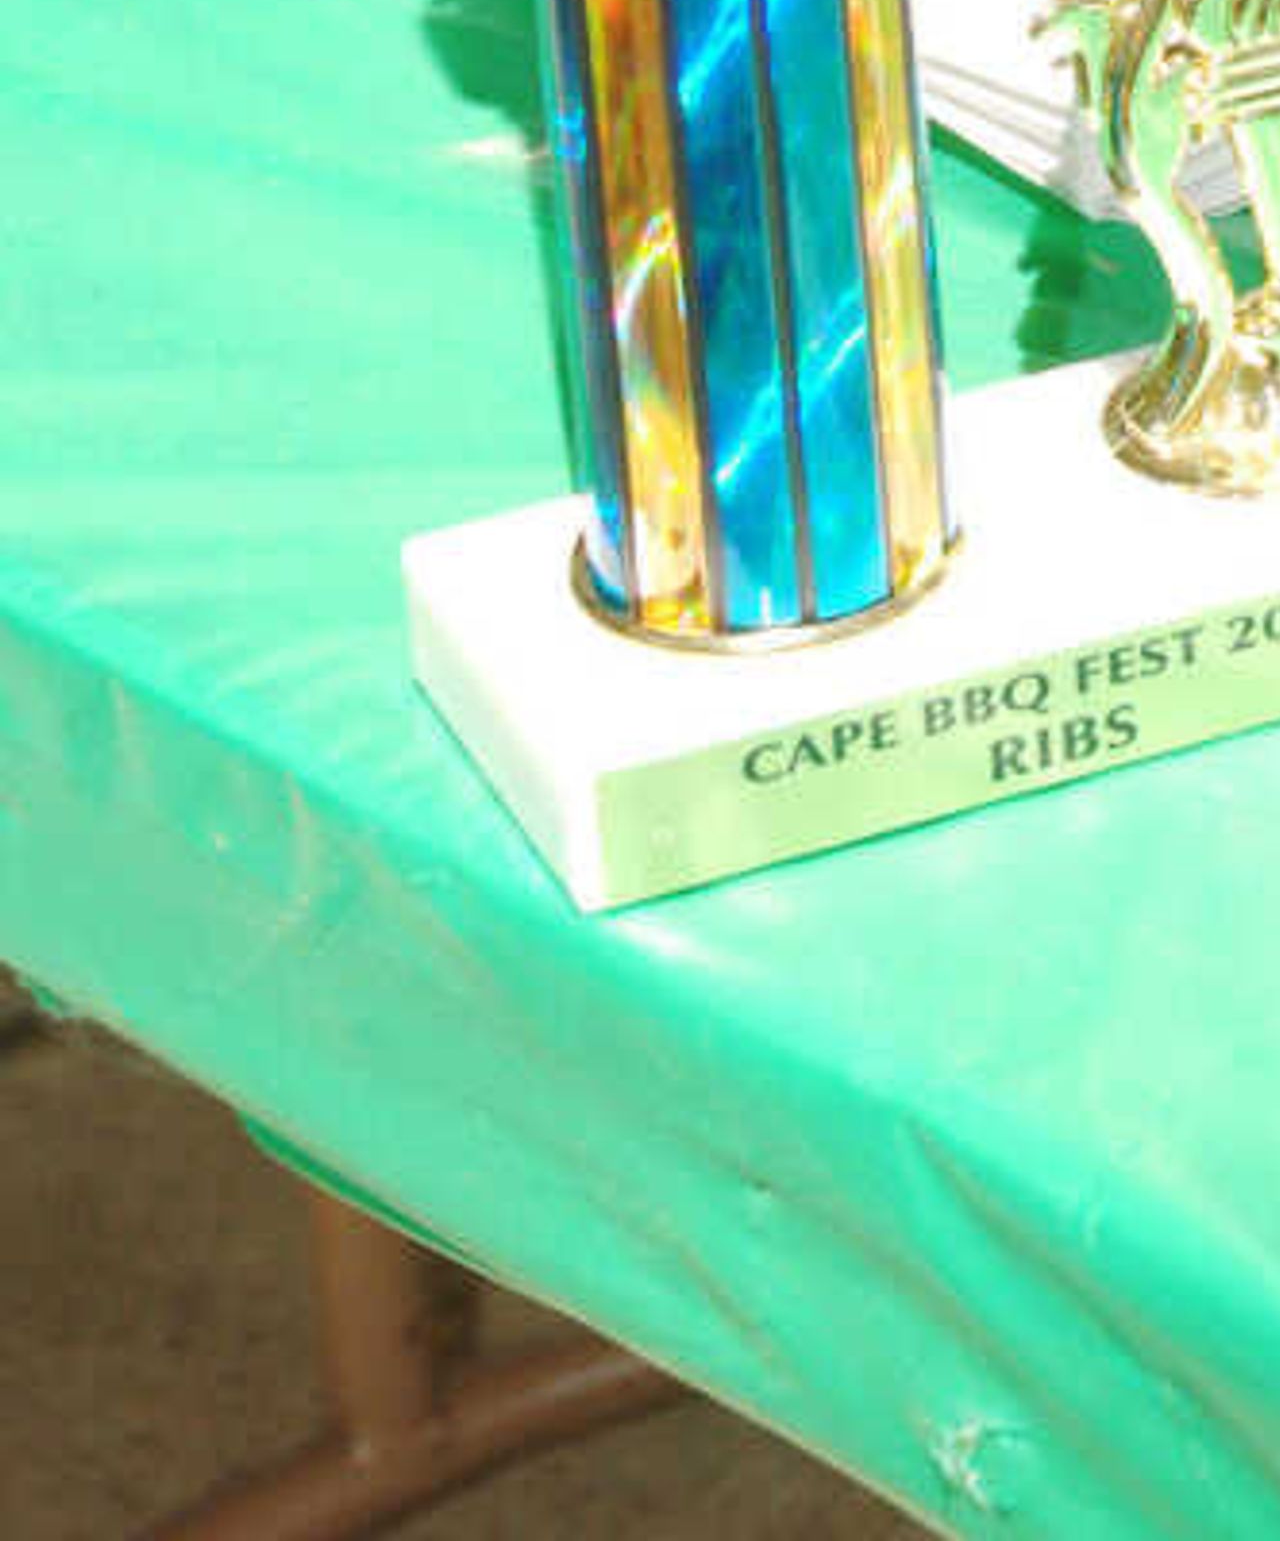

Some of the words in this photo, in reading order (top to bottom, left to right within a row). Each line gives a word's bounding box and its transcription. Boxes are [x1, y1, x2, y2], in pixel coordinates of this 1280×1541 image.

[742, 711, 898, 786] CAPE
[922, 669, 1051, 739] BBQ
[1073, 627, 1202, 696] FEST
[988, 703, 1139, 783] RIBS
